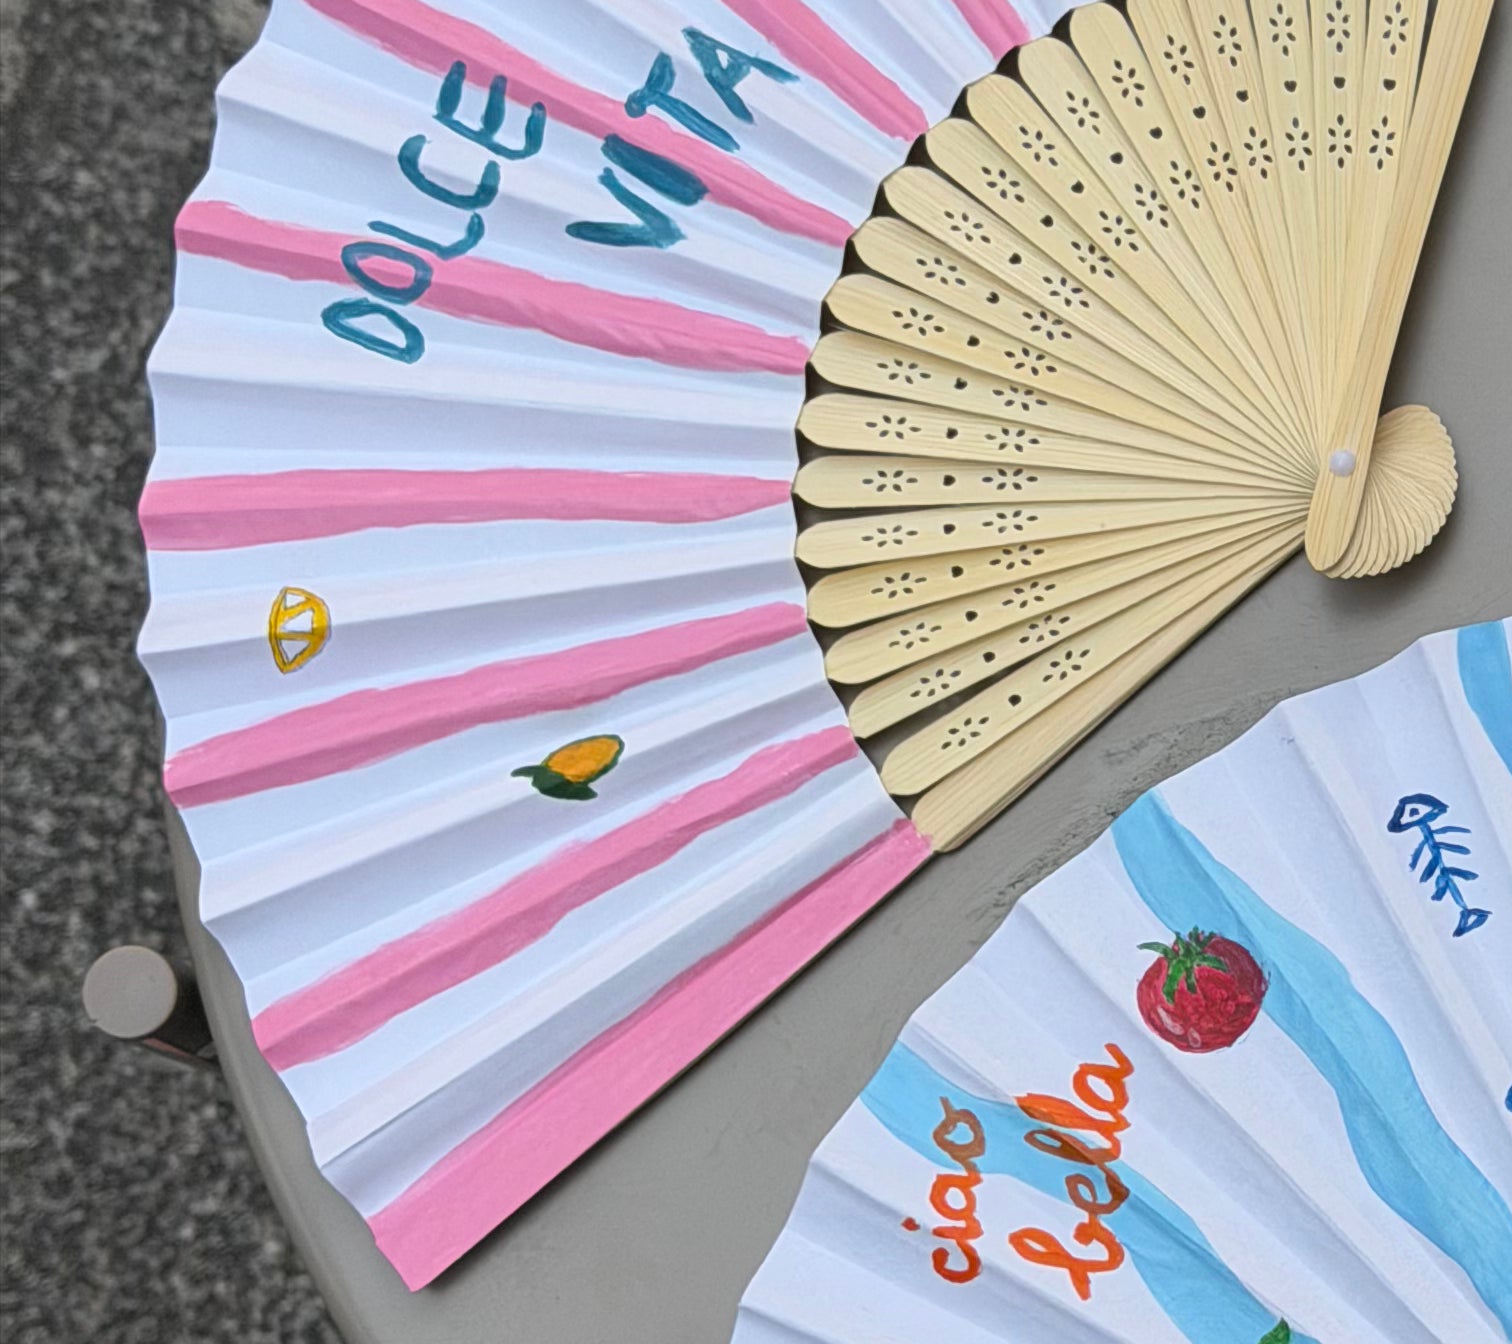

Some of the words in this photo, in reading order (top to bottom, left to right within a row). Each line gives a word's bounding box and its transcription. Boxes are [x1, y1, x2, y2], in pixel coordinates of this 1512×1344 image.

[321, 60, 547, 364] DOLCE
[565, 26, 801, 249] VITA
[901, 1096, 986, 1284] ciao
[1008, 1042, 1135, 1301] bella
